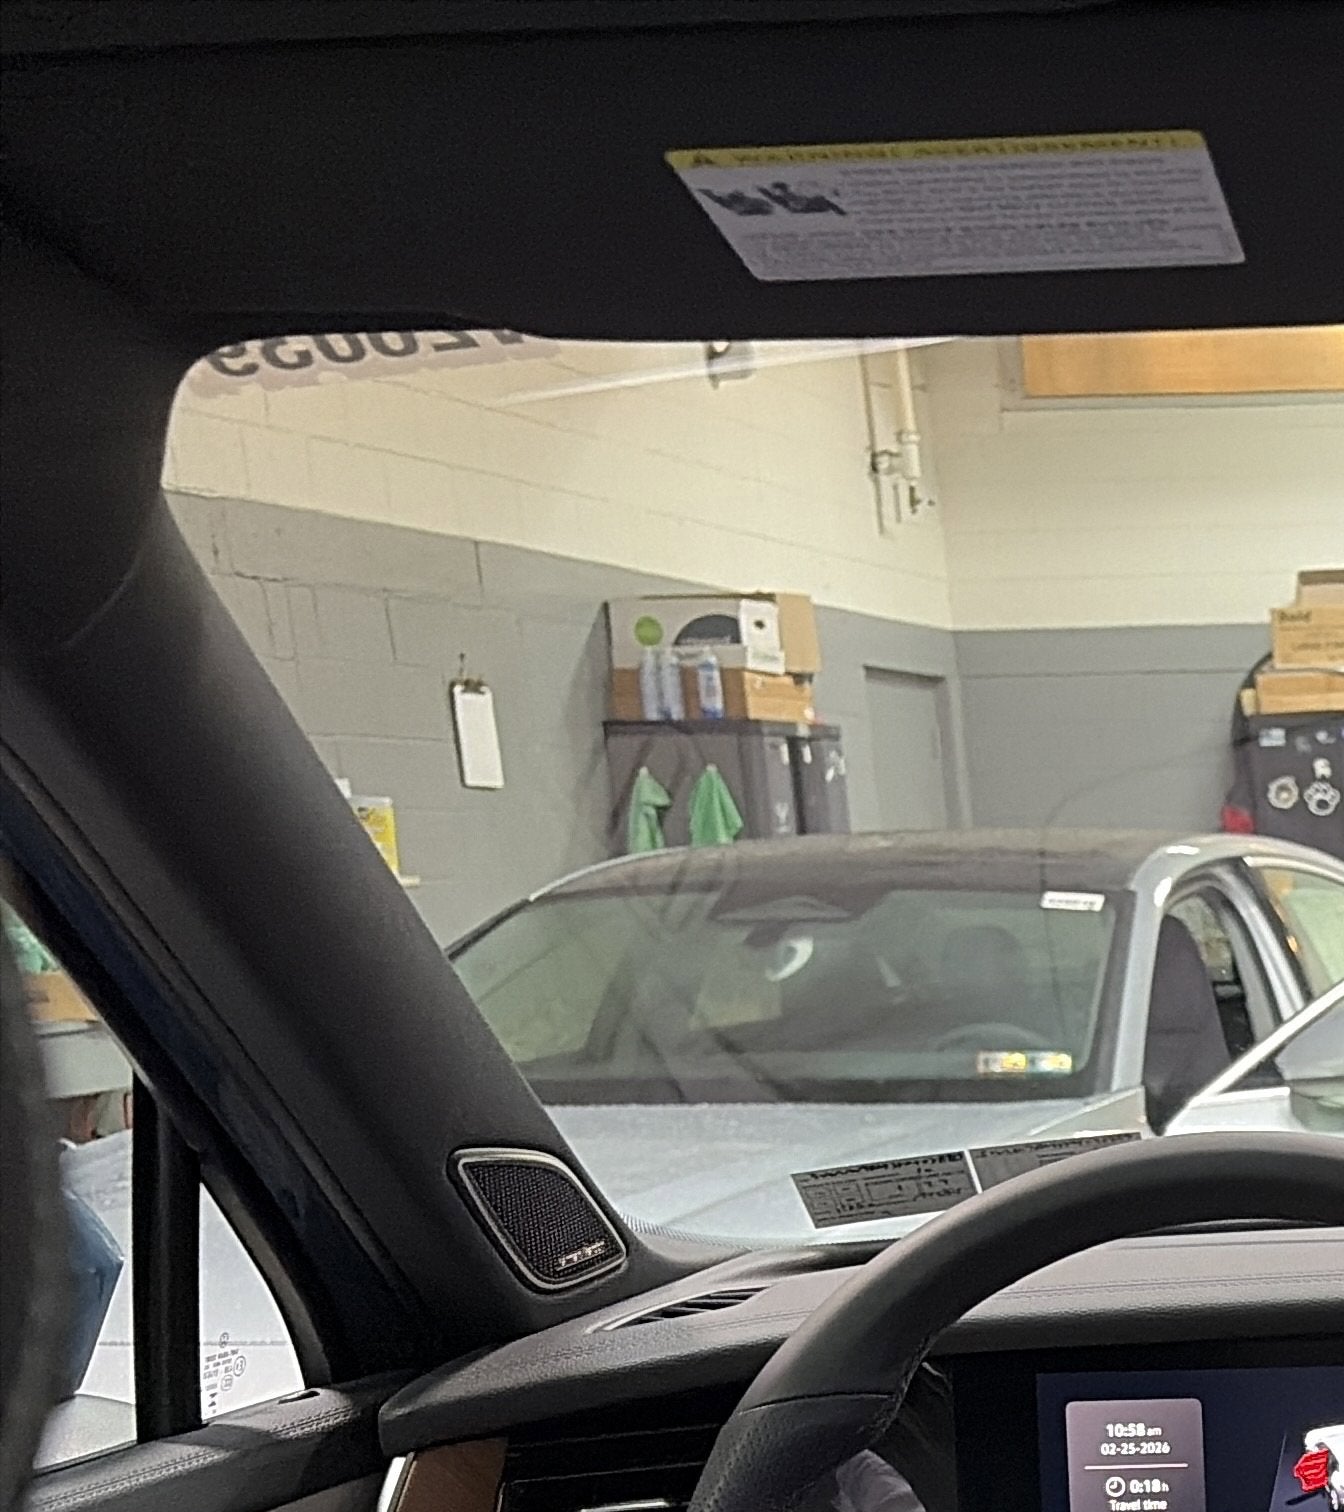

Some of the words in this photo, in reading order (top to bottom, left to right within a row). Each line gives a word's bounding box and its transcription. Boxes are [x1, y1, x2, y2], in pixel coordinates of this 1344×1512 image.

[1106, 1423, 1145, 1437] 10:58
[1100, 1442, 1171, 1455] 02-25-2026
[1129, 1478, 1161, 1493] 0:18
[1108, 1499, 1140, 1511] Travel
[1143, 1499, 1168, 1511] time
